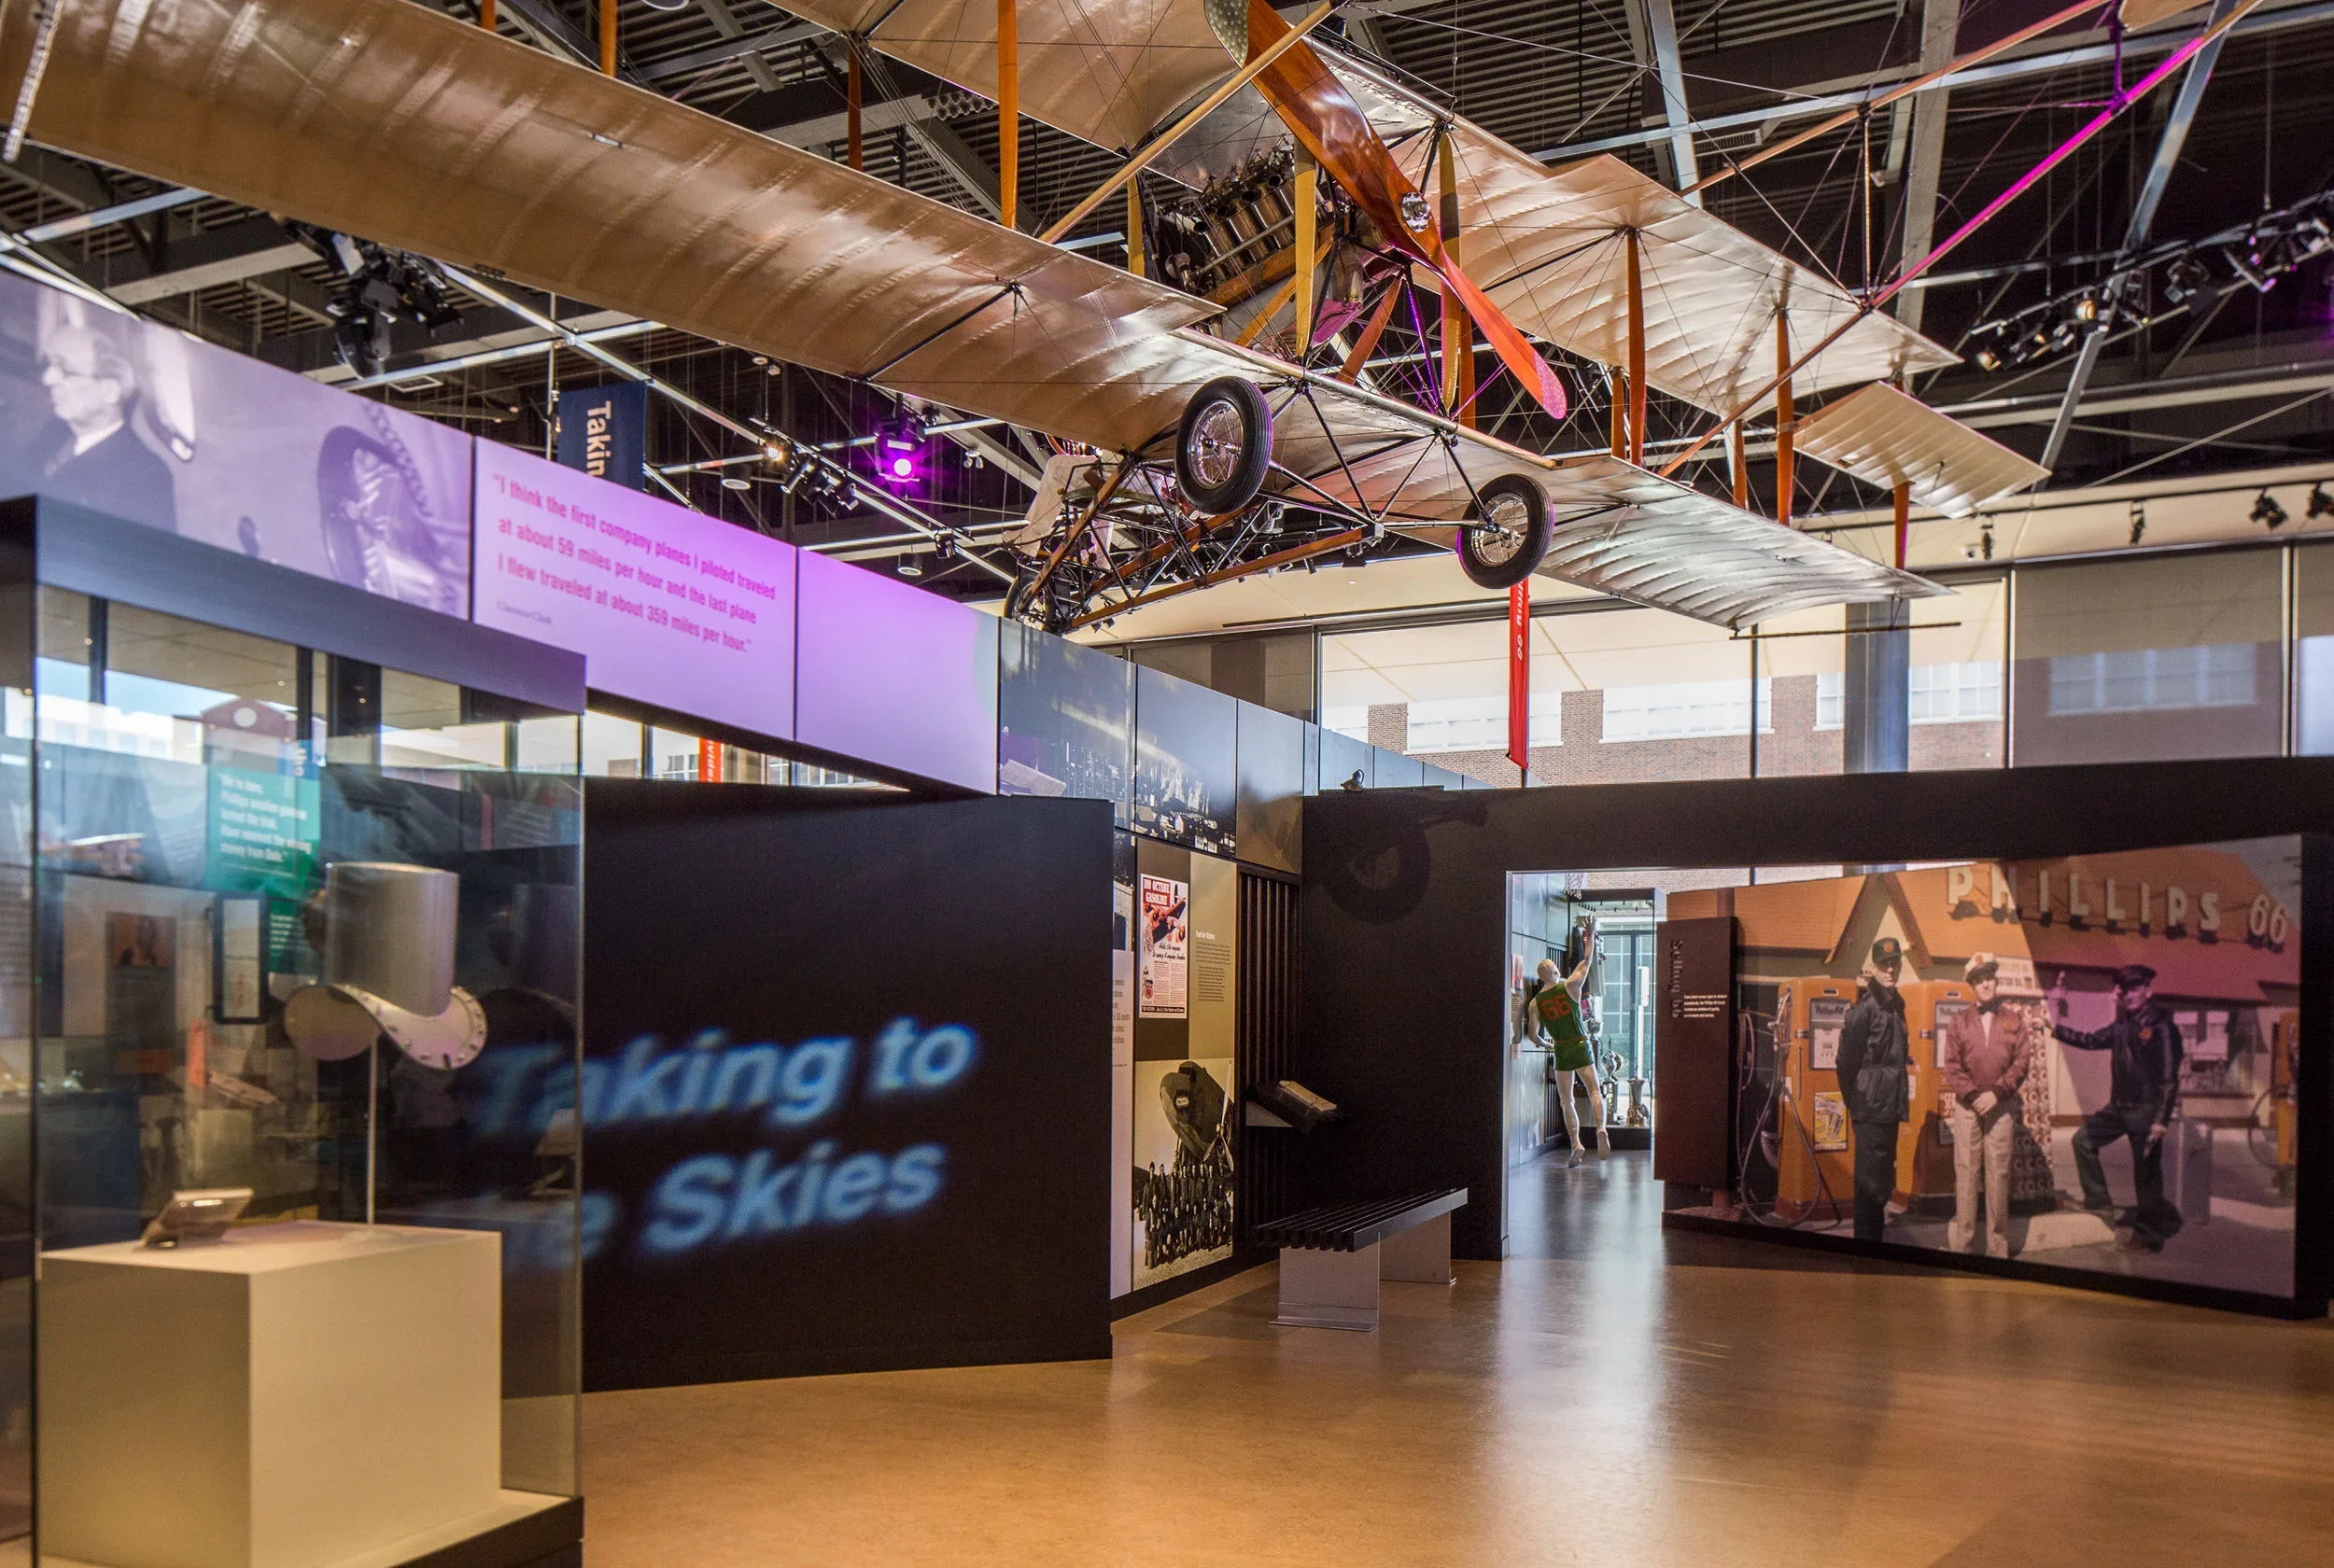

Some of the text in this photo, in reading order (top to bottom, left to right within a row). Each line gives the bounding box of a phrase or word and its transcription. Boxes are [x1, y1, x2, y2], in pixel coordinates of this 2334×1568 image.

[498, 518, 757, 625] at about 59 miles per hour and the last plane
[510, 480, 542, 509] think
[547, 495, 568, 518] the
[571, 505, 597, 530] first
[599, 520, 652, 554] company
[655, 541, 691, 567] planes
[701, 560, 735, 584] piloted
[738, 572, 776, 600] traveled
[508, 555, 536, 581] flew
[540, 568, 593, 602] traveled
[596, 590, 609, 607] at
[612, 595, 643, 618] about
[647, 605, 668, 626] 359
[671, 616, 700, 637] miles
[703, 627, 719, 643] per
[1516, 634, 1524, 661] 66
[1947, 865, 2289, 944] PHILLIPS 66
[1541, 993, 1572, 1021] 66
[1670, 940, 1683, 992] Selling
[480, 1014, 977, 1136] Taking to
[641, 1140, 949, 1254] Skies
